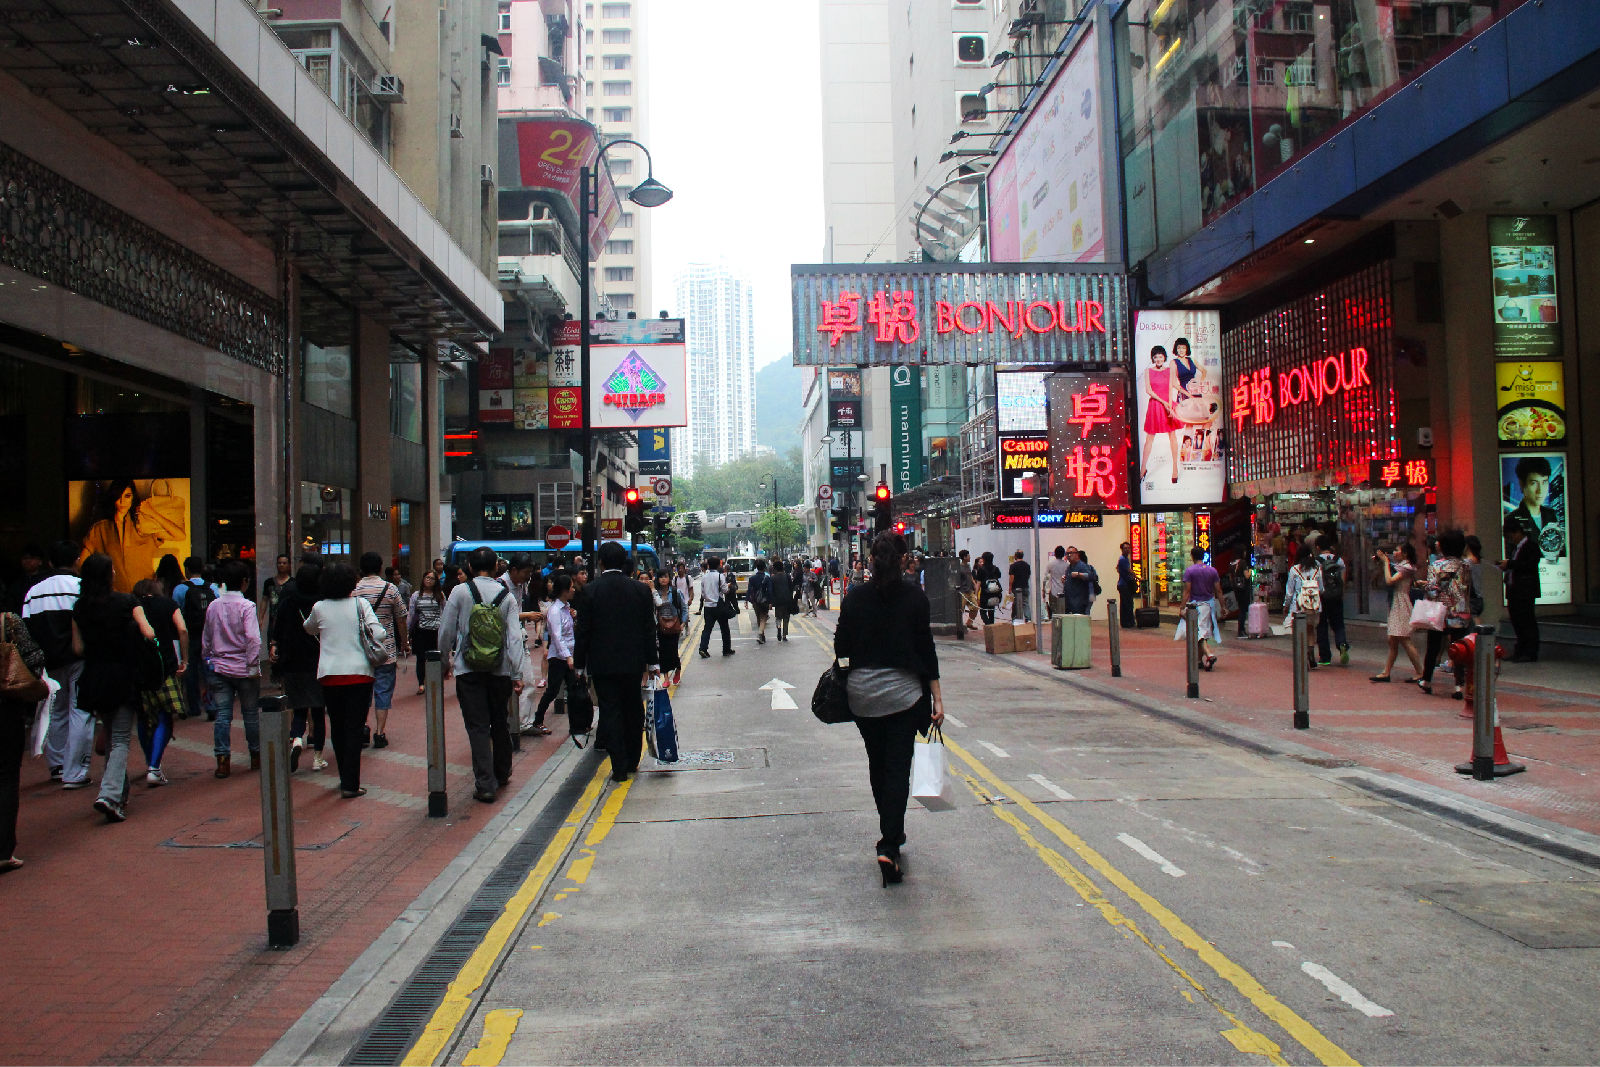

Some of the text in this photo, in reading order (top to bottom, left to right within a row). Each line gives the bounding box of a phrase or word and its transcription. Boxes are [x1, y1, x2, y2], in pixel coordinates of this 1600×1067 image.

[540, 129, 590, 167] 24
[936, 300, 1106, 339] BONJOUR
[1278, 347, 1371, 407] BONJOUR
[603, 393, 666, 404] OUTBACK
[901, 405, 911, 491] mannings
[996, 514, 1032, 523] Canon
[1065, 511, 1099, 523] Nikon
[1131, 525, 1141, 560] Canon
